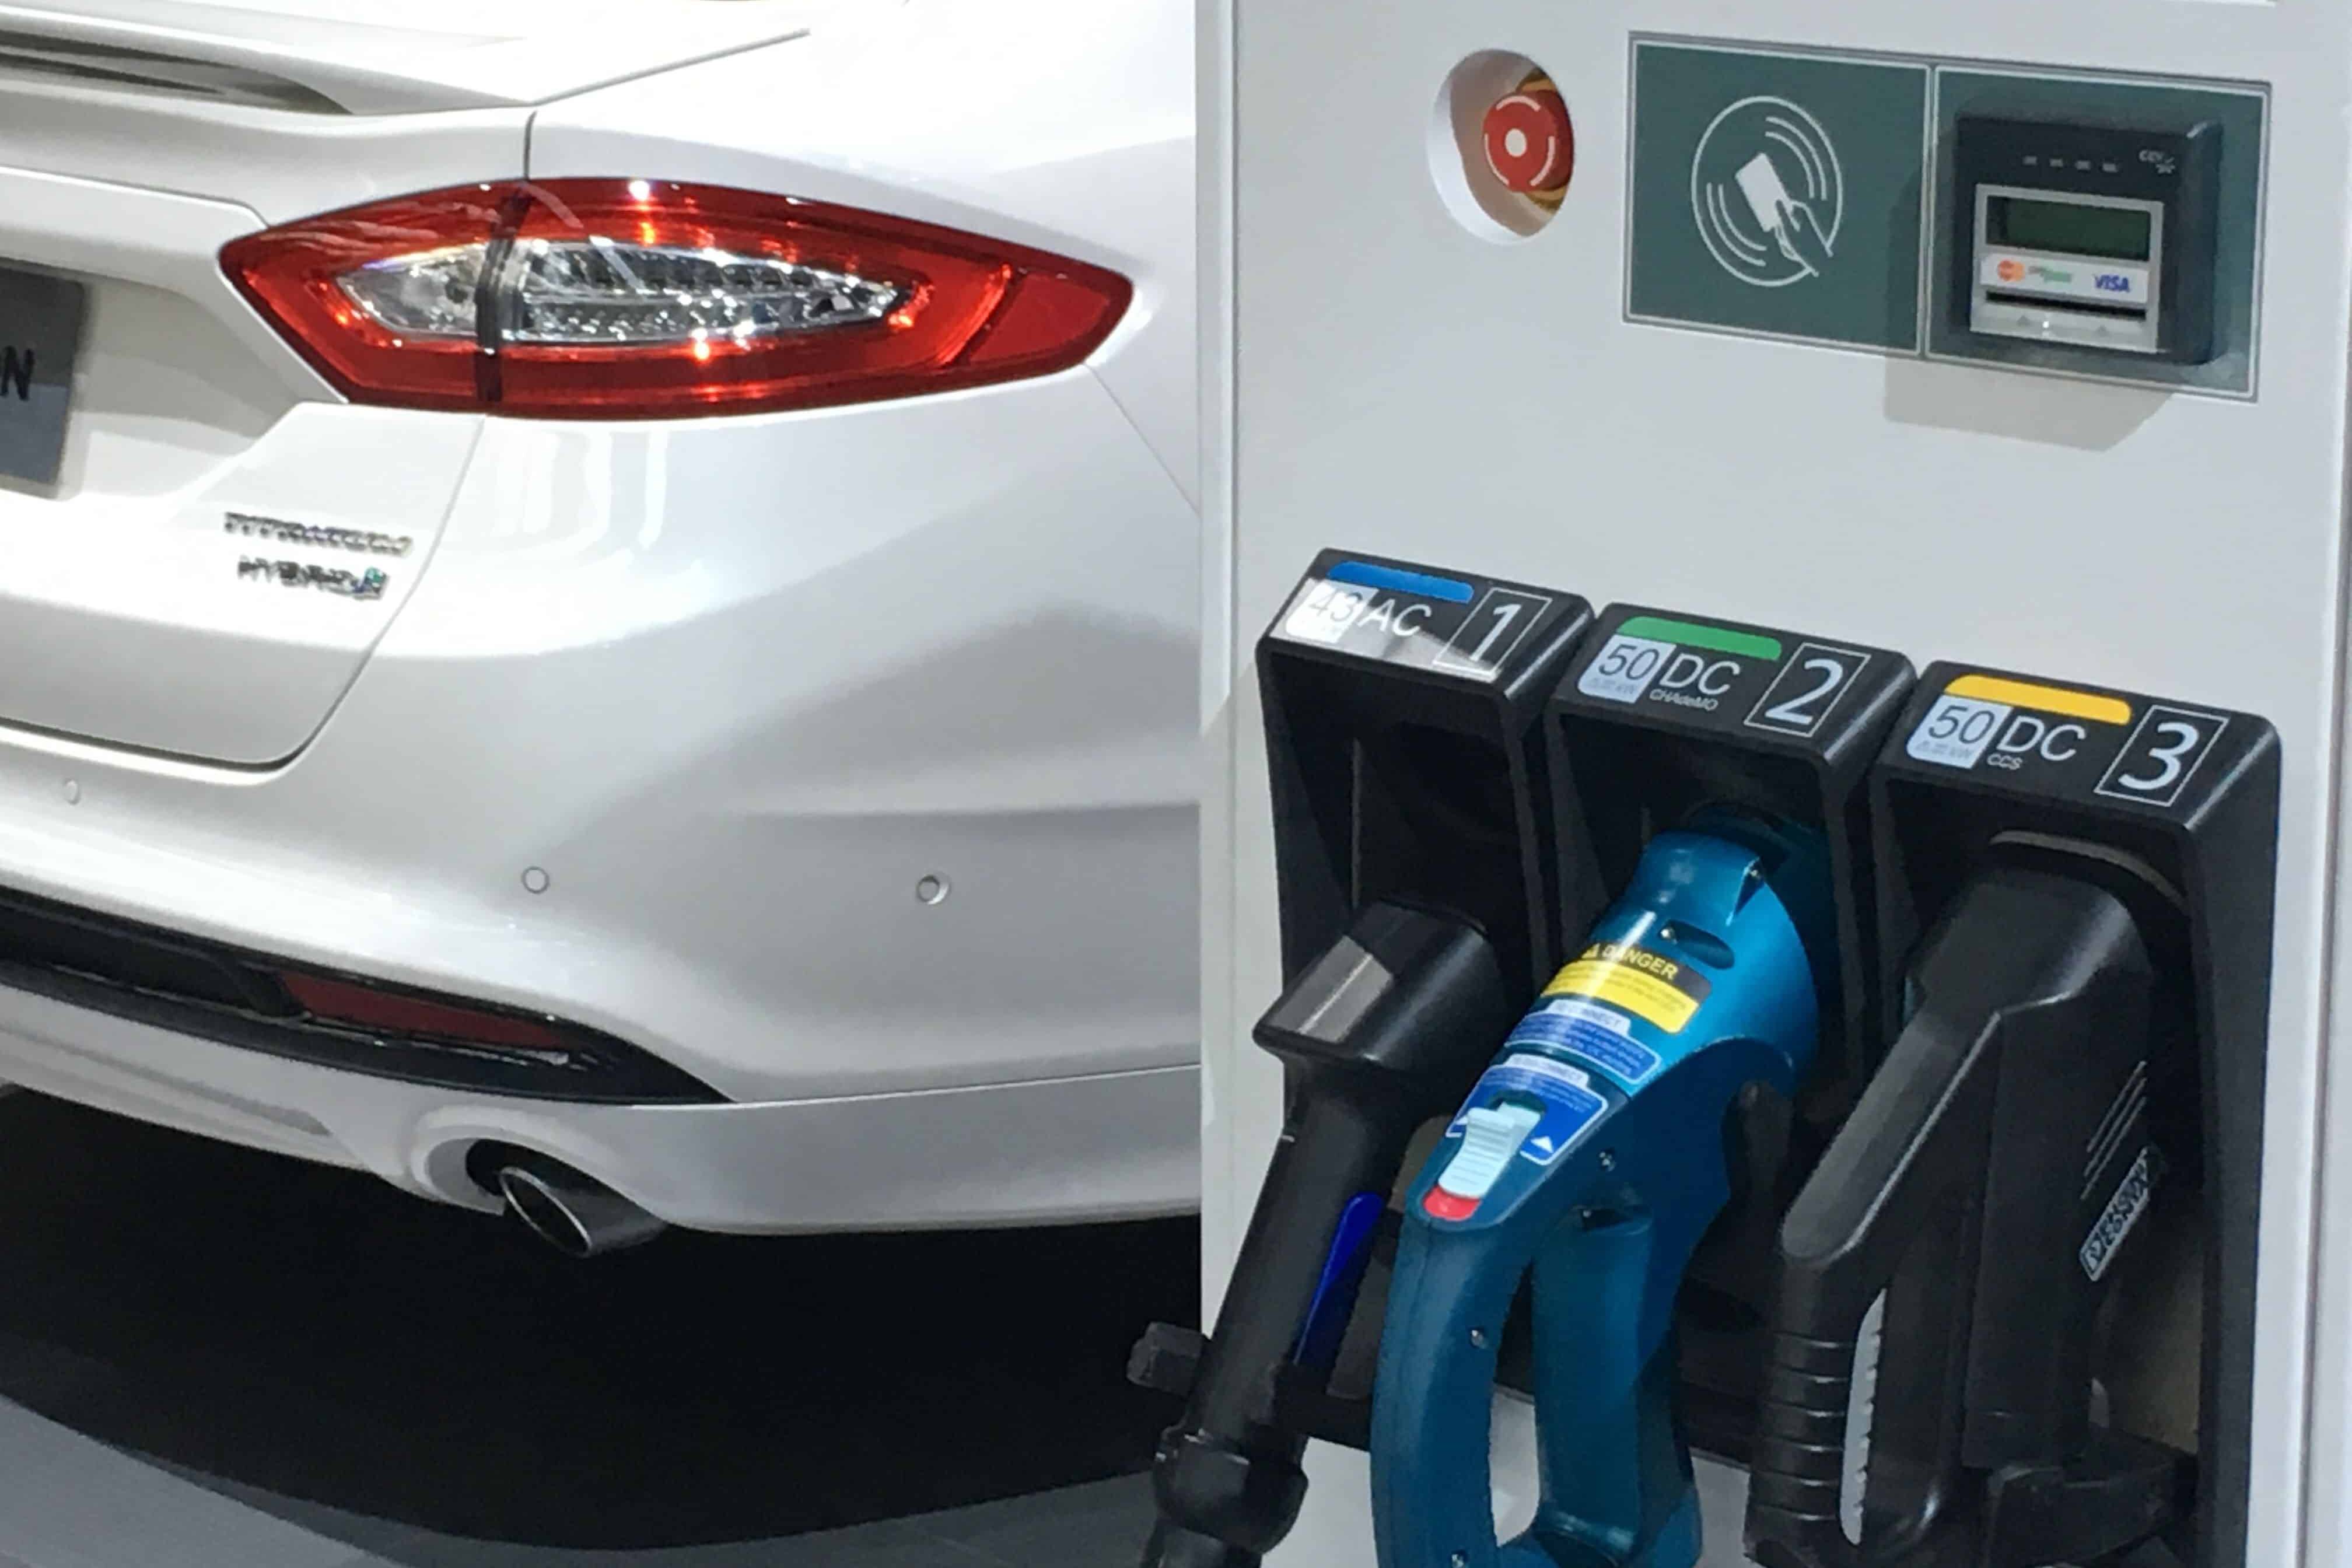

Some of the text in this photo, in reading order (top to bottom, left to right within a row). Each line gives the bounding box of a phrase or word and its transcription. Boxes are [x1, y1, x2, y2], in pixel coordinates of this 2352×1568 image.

[2094, 274, 2130, 293] VISA
[1357, 598, 1432, 636] AC
[1469, 604, 1522, 662] 1
[1598, 643, 1660, 680] 50
[1659, 653, 1741, 695] DC
[1765, 659, 1843, 724] 2
[1928, 705, 1995, 744] 50
[1996, 715, 2087, 761] DC
[2118, 722, 2199, 790] 3
[1986, 753, 2024, 771] CCS
